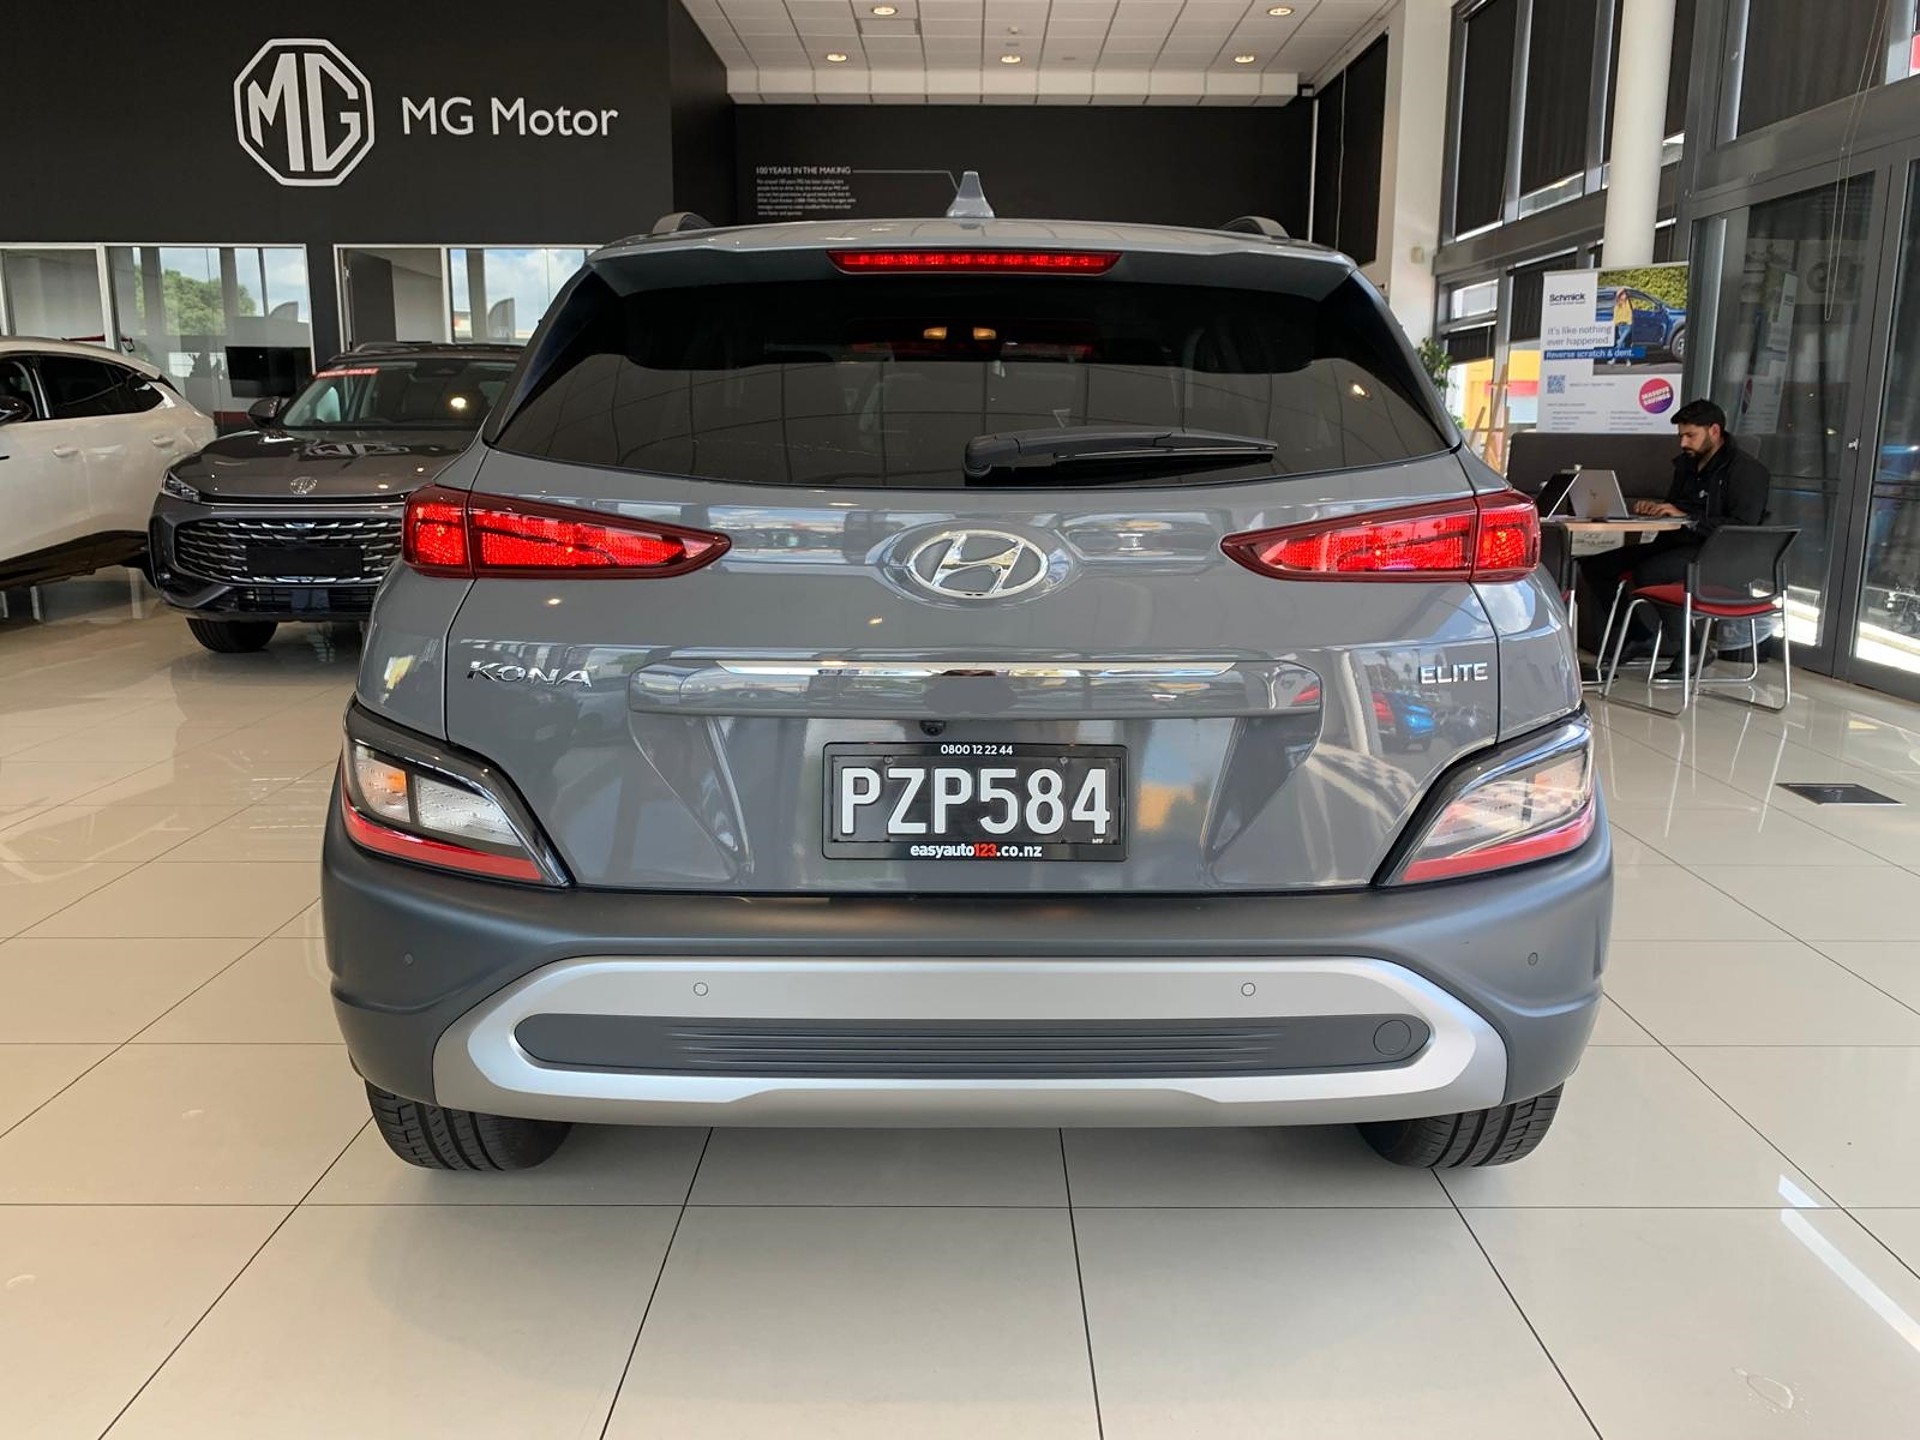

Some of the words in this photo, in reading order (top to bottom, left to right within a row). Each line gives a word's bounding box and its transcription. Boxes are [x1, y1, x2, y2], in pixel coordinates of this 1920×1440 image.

[247, 52, 362, 172] MG
[402, 97, 474, 136] MG
[491, 97, 618, 136] Motor
[769, 166, 791, 175] YEARS
[803, 166, 817, 175] THE
[819, 166, 851, 175] MAKING
[1549, 292, 1585, 302] Schmick
[1562, 326, 1577, 335] like
[1579, 325, 1612, 336] nothing
[1546, 350, 1575, 358] Reverse
[1577, 349, 1606, 358] scratch
[1607, 349, 1613, 357] &
[467, 660, 592, 688] KONA
[1419, 662, 1489, 684] ELITE
[941, 744, 970, 755] 0800
[972, 744, 983, 755] 12
[984, 744, 998, 755] 22
[999, 744, 1013, 755] 44
[840, 767, 1112, 836] PZP584
[909, 842, 1043, 859] easyauto123.co.nz
